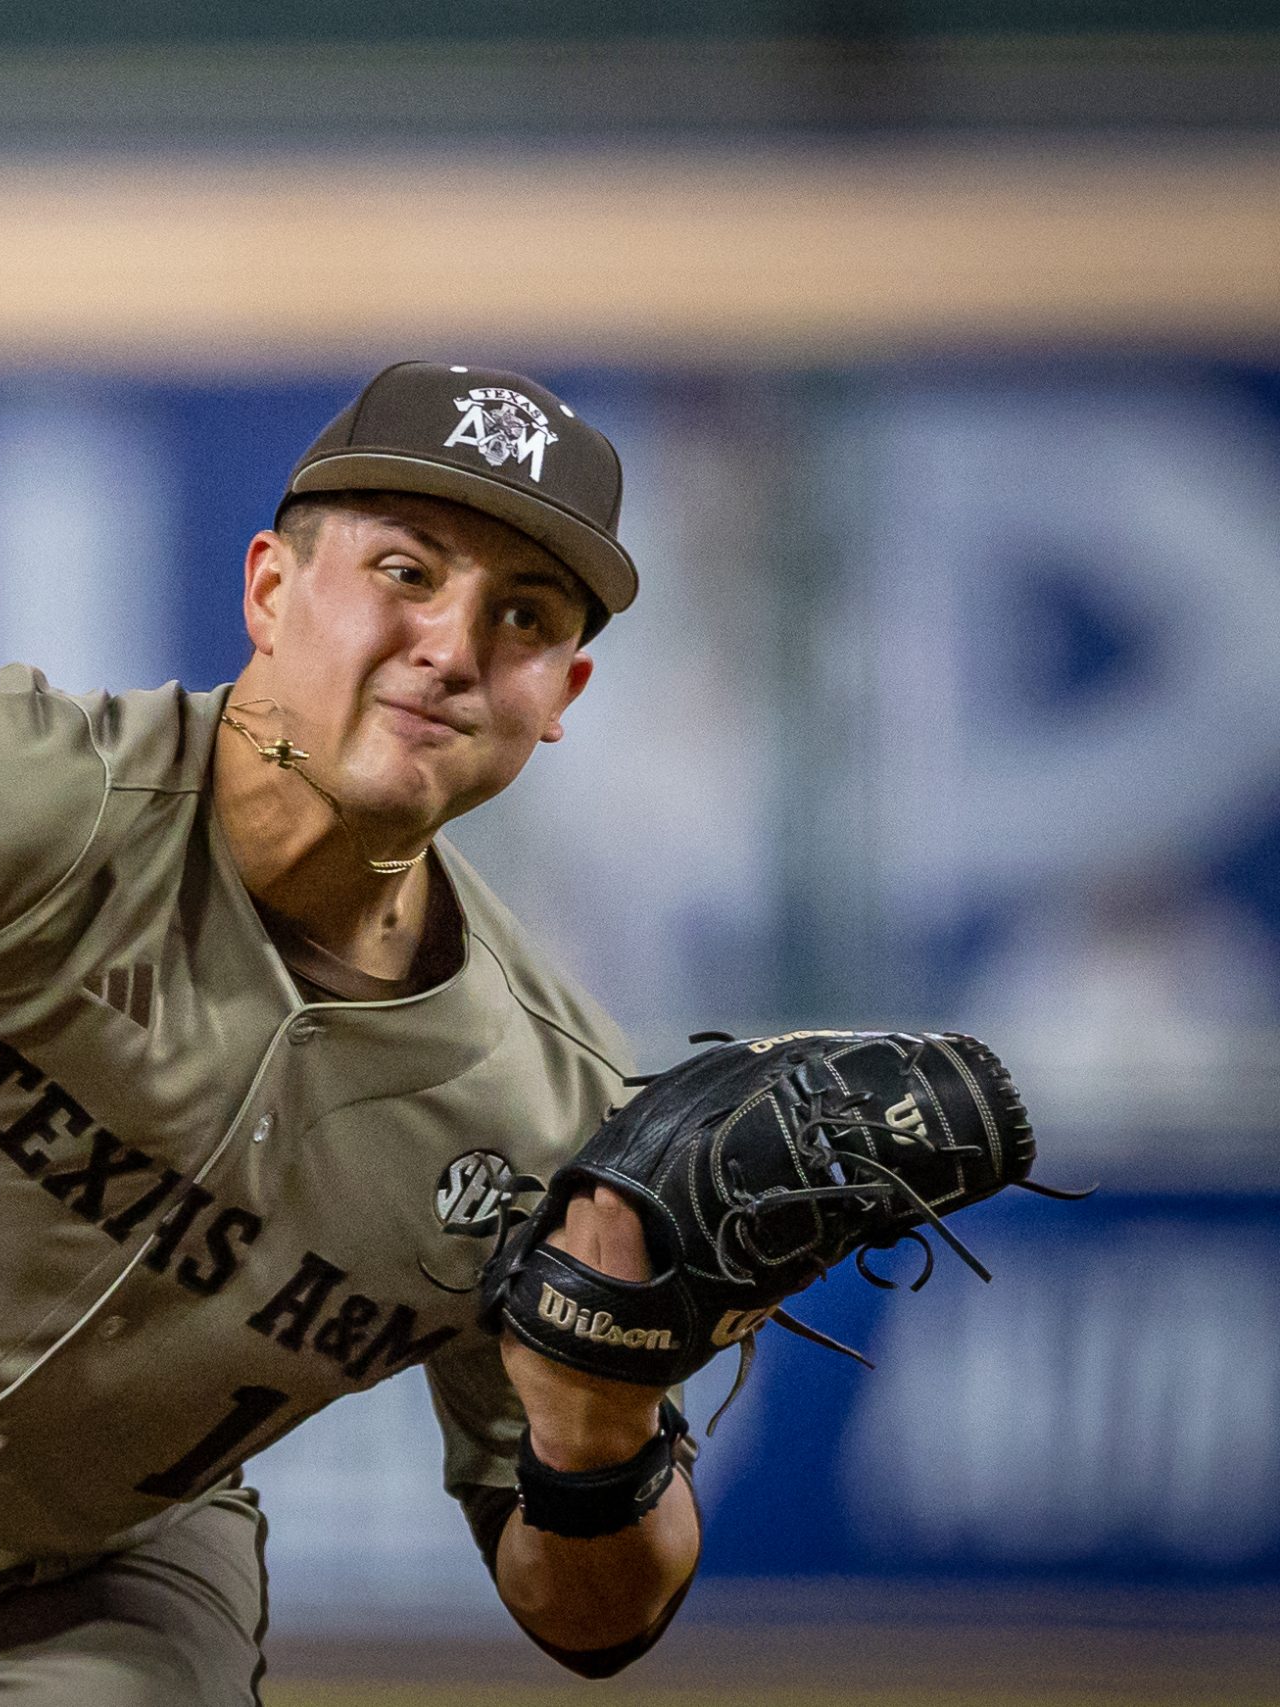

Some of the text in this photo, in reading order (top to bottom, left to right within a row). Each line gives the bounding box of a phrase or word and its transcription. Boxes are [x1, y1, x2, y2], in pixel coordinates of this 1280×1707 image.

[478, 388, 543, 420] TEXAS
[246, 1251, 462, 1379] A&M
[537, 1281, 674, 1350] Wilson
[133, 1384, 291, 1499] 1
